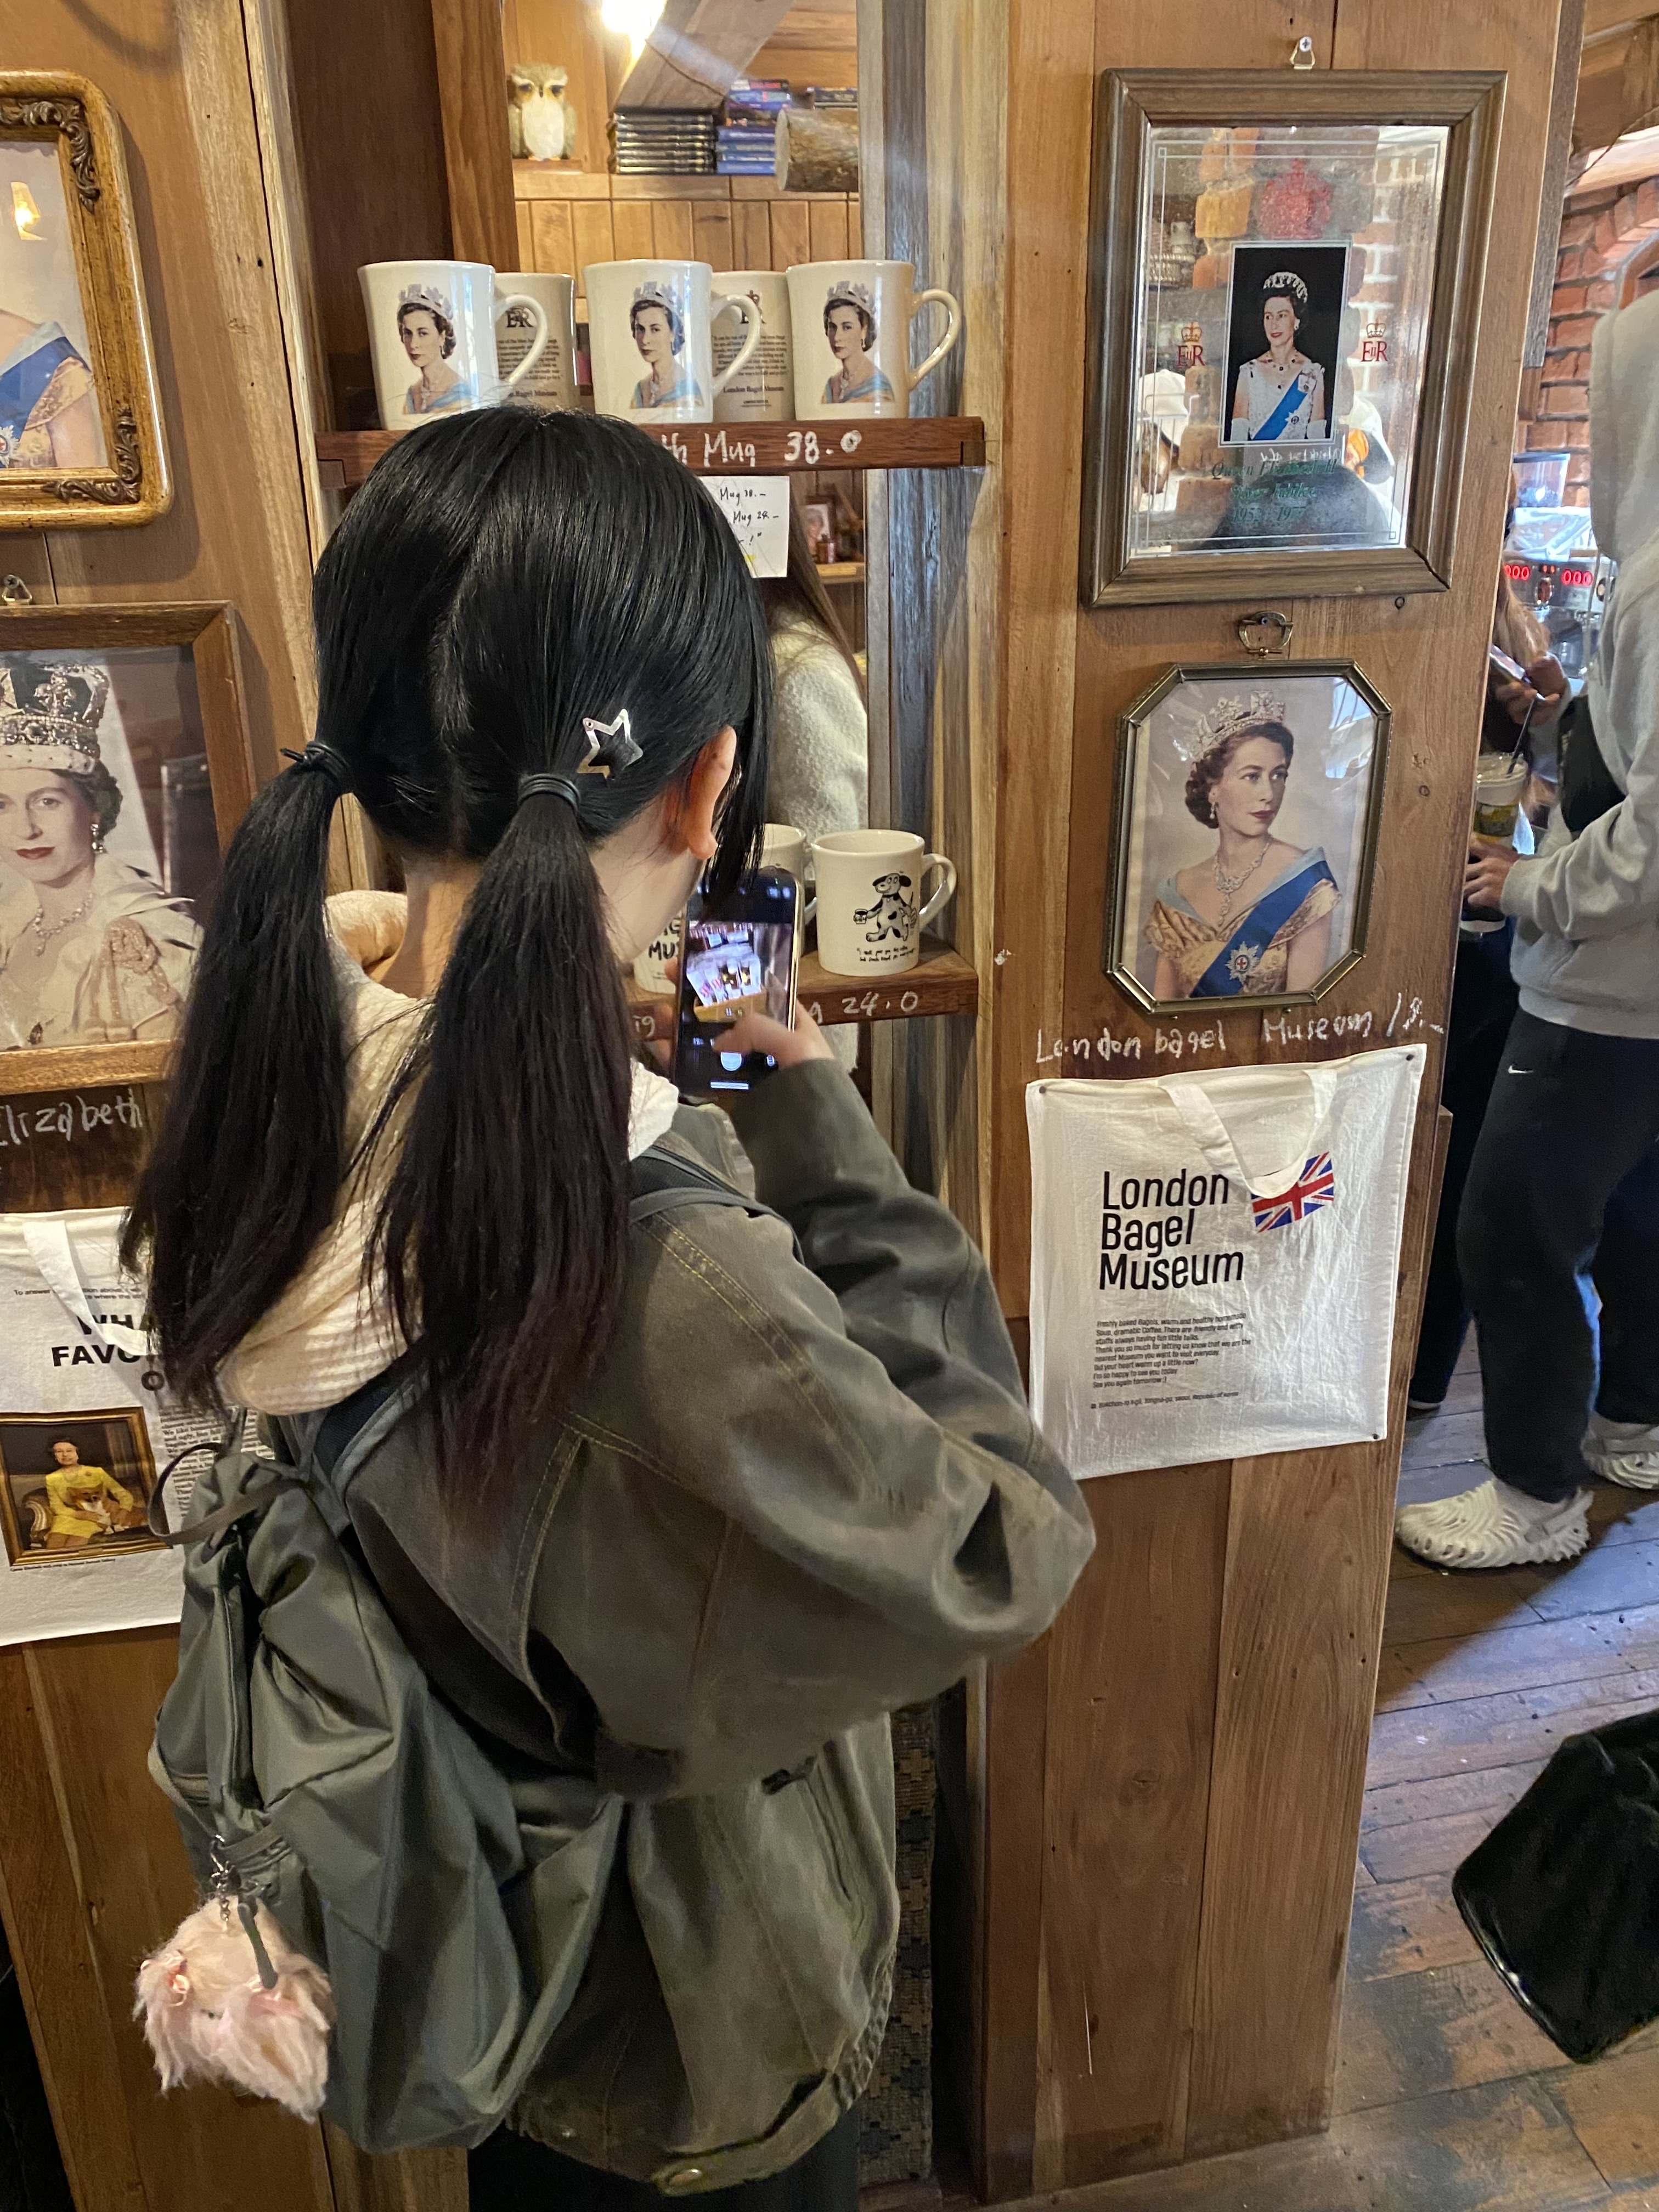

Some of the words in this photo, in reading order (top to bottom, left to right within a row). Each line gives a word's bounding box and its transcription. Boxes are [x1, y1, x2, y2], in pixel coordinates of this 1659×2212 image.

[703, 430, 755, 467] Mug
[720, 487, 740, 506] Mug
[733, 511, 752, 527] Mug
[1036, 1026, 1141, 1063] London
[1154, 1019, 1226, 1059] bagel
[1263, 1011, 1373, 1045] Museum
[1103, 1168, 1229, 1210] London
[1102, 1208, 1195, 1257] Bagel
[1099, 1251, 1244, 1290] Museum
[1215, 1313, 1246, 1322] homemade
